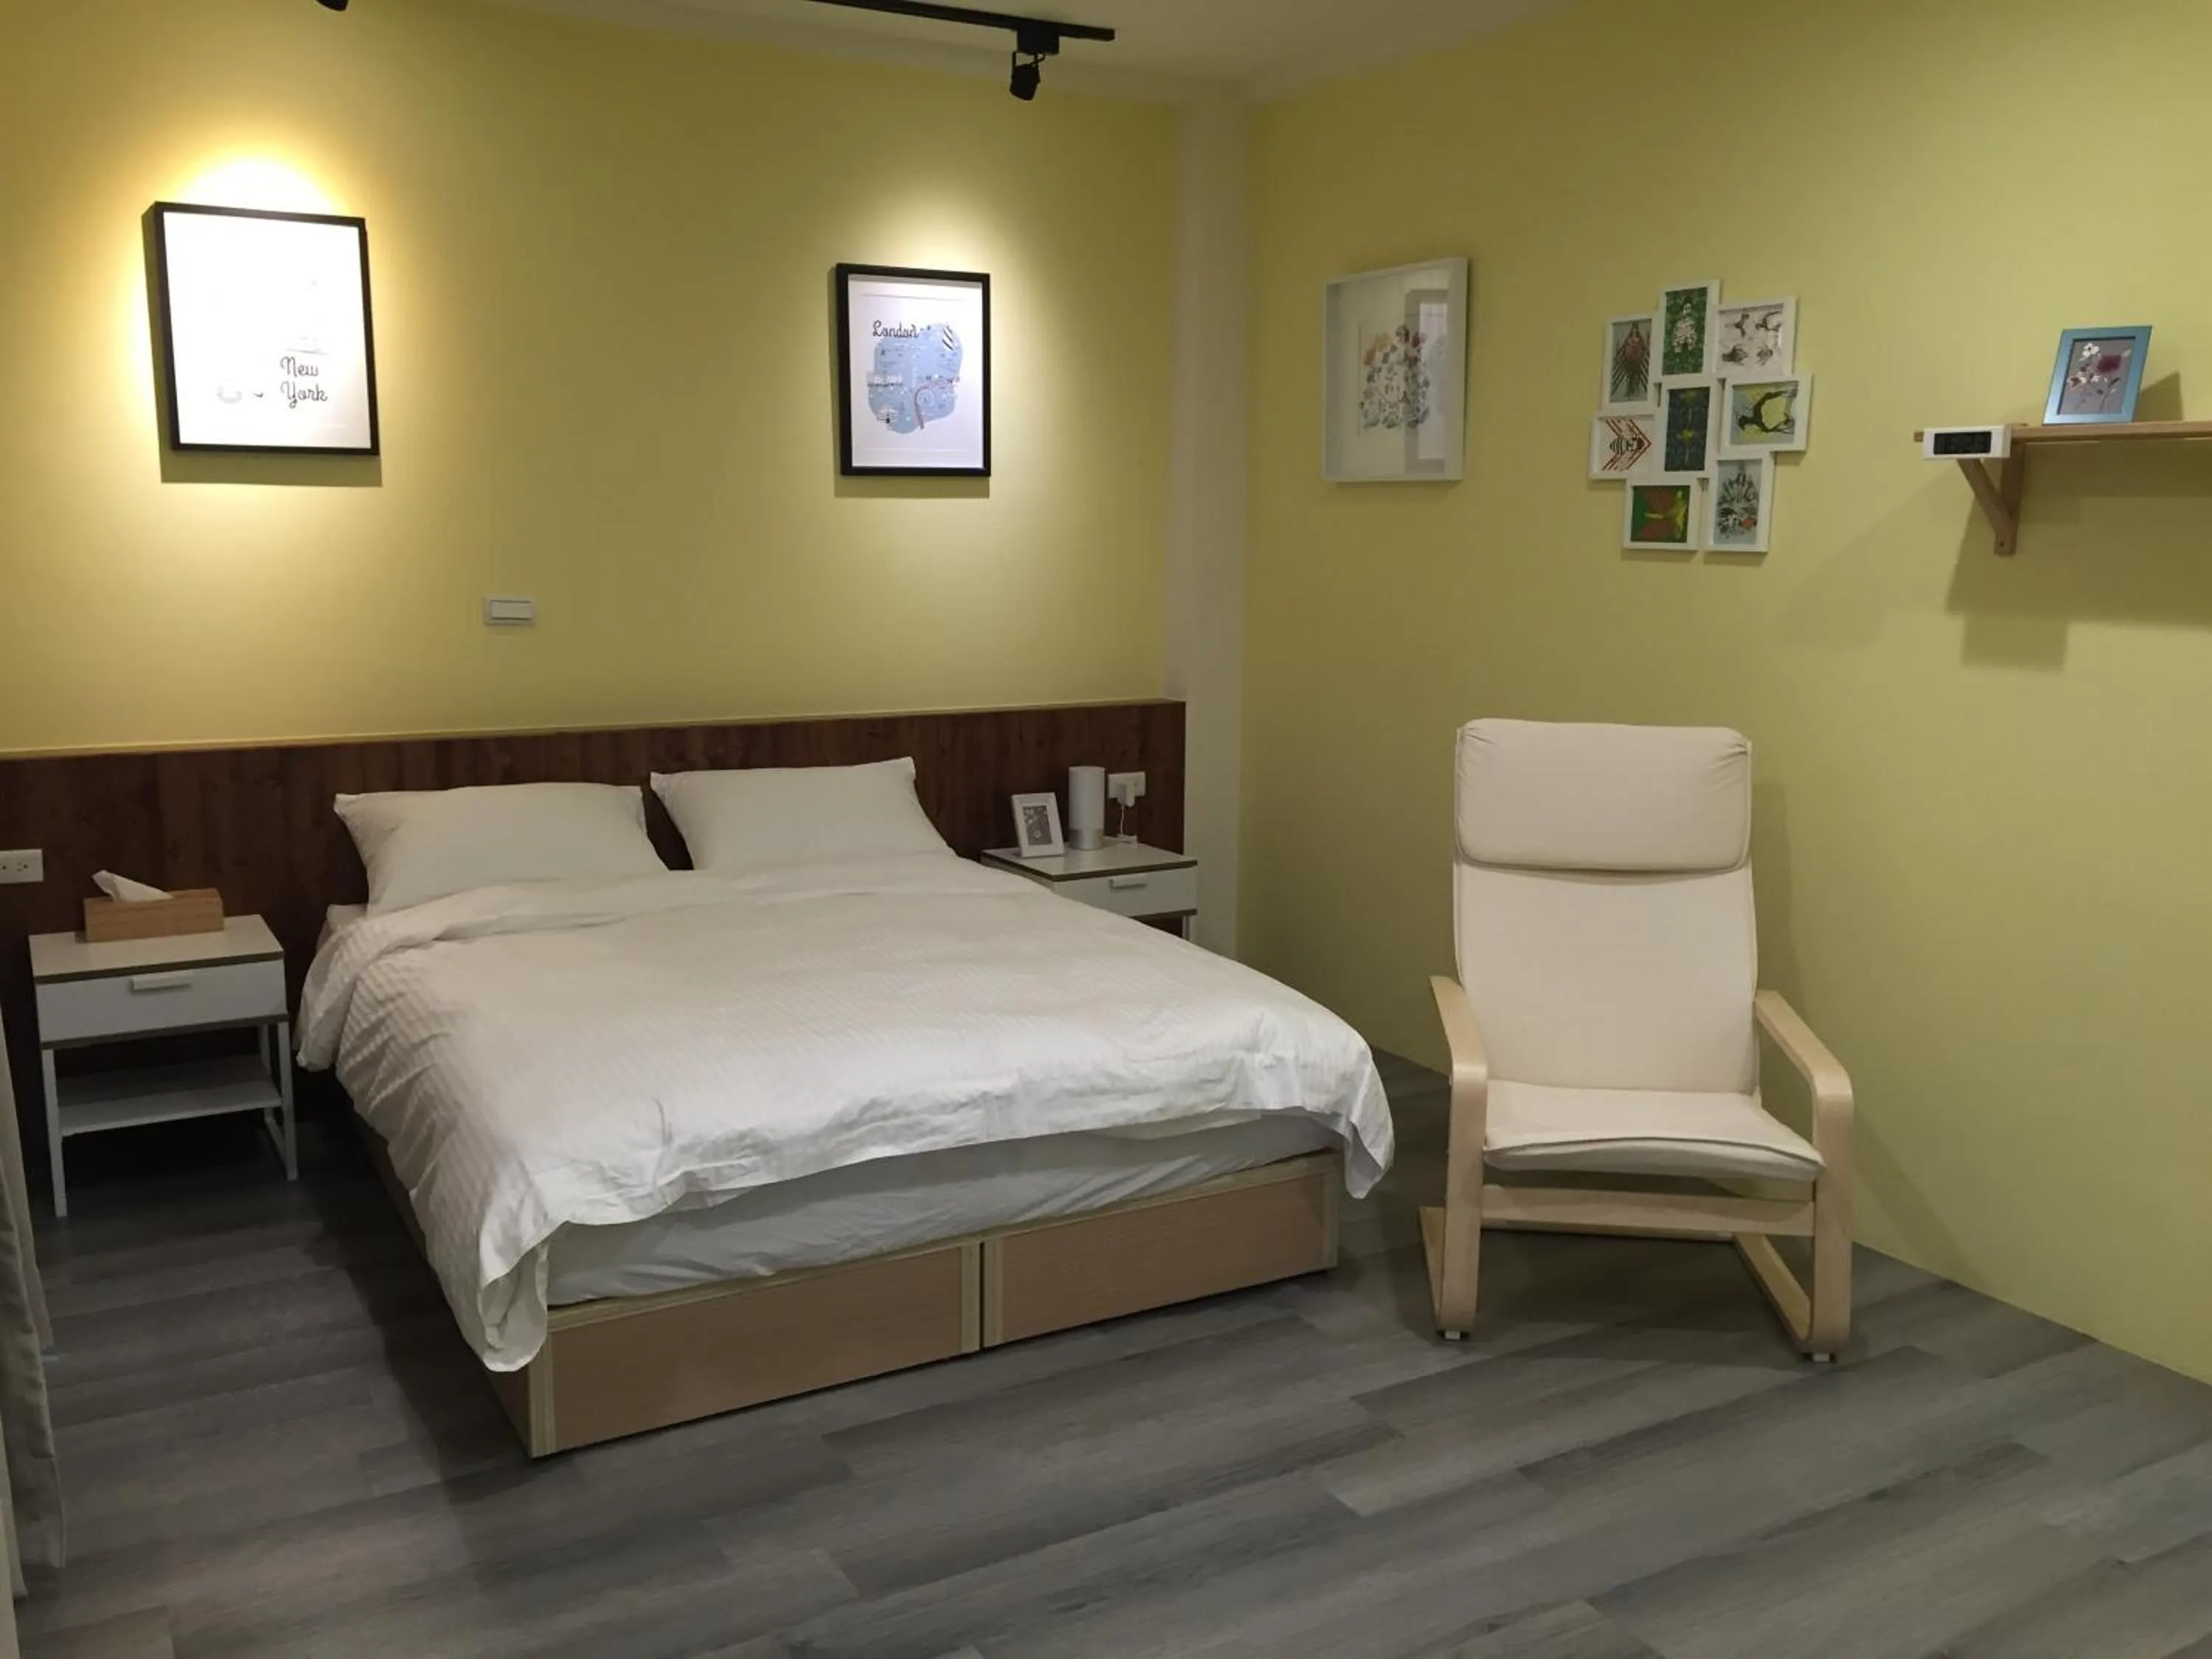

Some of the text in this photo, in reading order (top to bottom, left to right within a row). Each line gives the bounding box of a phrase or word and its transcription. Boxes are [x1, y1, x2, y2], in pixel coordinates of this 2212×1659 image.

[872, 320, 919, 338] London
[279, 356, 319, 378] New
[279, 380, 328, 408] York
